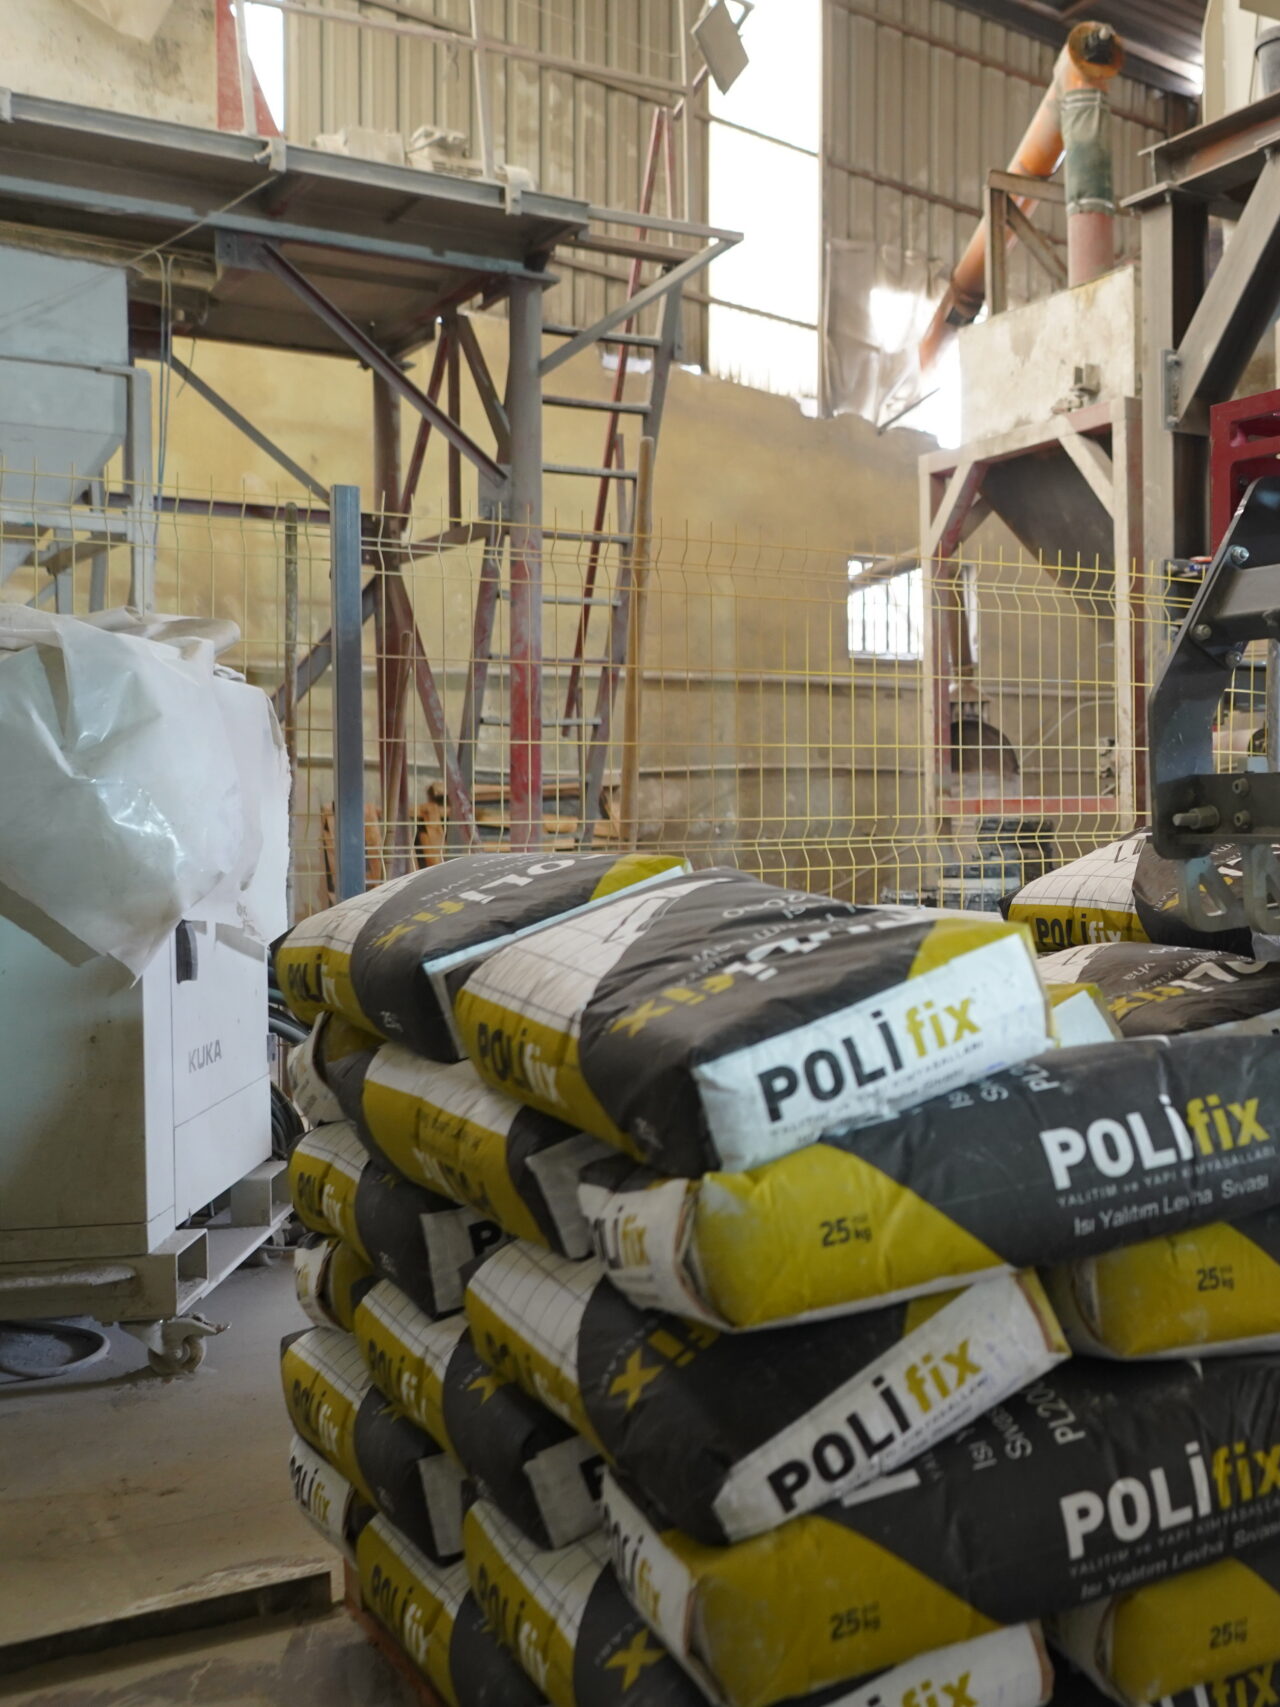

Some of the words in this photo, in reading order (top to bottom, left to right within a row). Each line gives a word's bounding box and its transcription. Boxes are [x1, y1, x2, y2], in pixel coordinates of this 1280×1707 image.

[188, 1040, 222, 1073] KUKA
[820, 1217, 850, 1247] 25
[1196, 1267, 1220, 1292] 25
